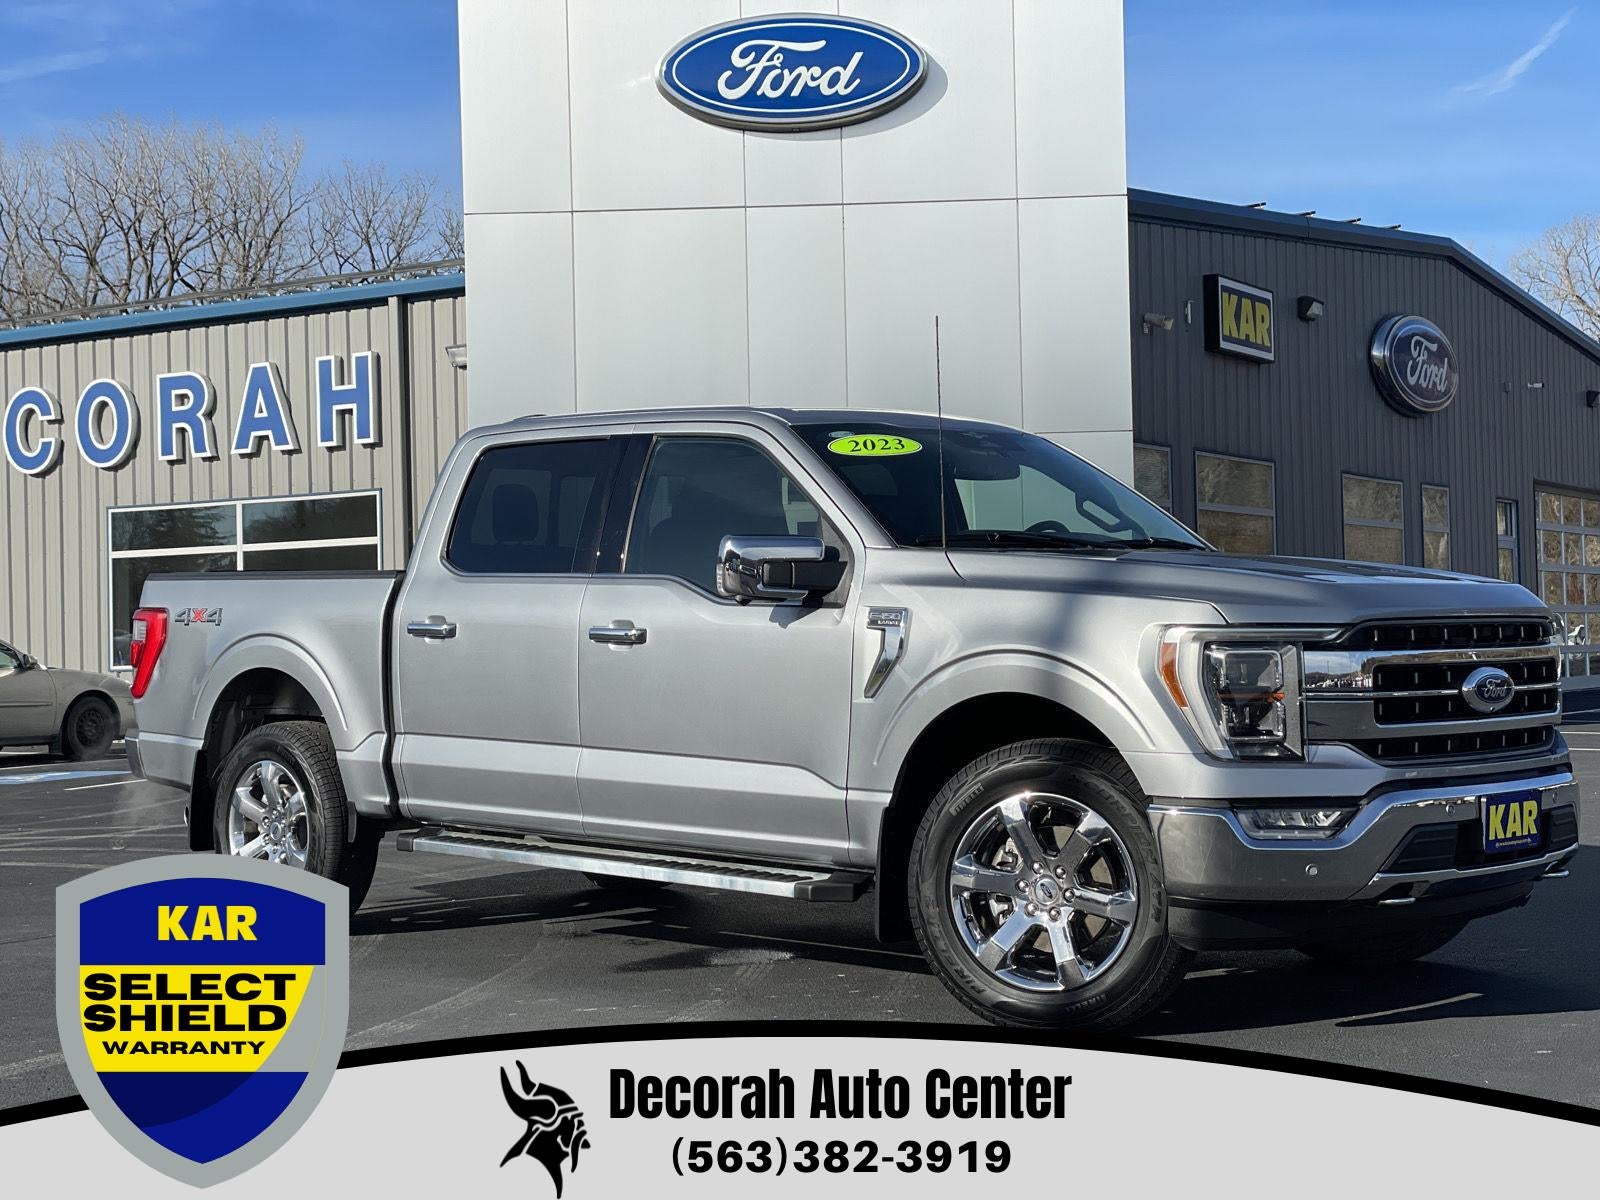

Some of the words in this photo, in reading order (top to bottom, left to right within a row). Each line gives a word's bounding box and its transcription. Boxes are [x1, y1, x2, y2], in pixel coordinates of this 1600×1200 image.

[717, 39, 864, 100] Ford
[1222, 291, 1271, 347] KAR
[1407, 335, 1448, 393] Ford
[3, 351, 378, 475] CORAH
[847, 438, 905, 452] 2023
[1482, 678, 1506, 698] Ford
[1489, 800, 1538, 841] KAR
